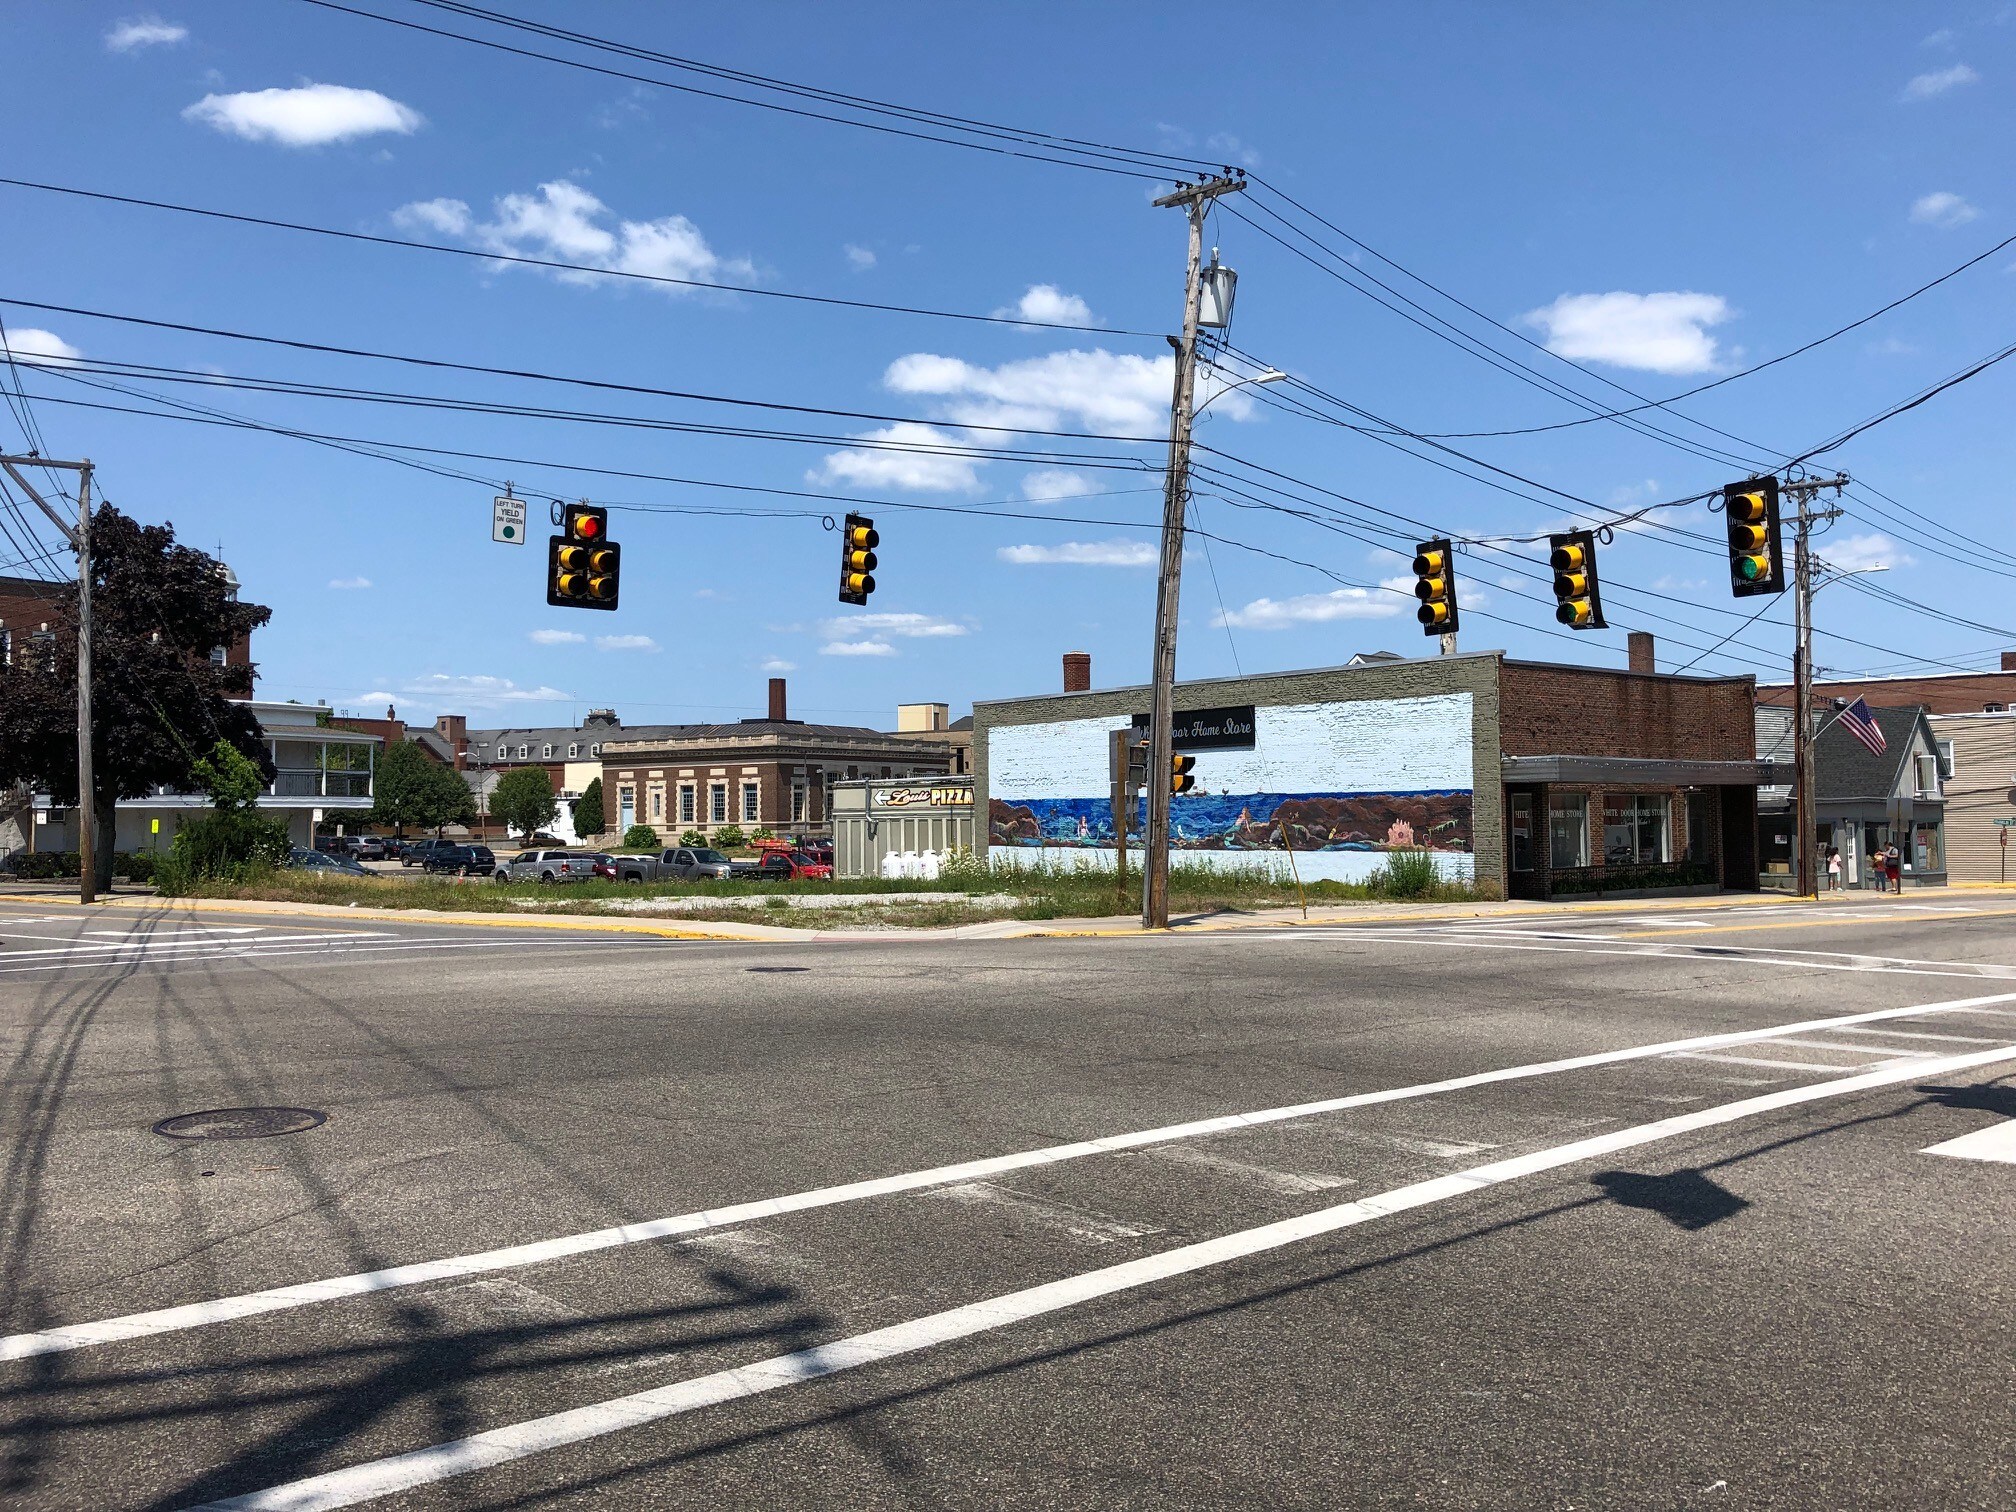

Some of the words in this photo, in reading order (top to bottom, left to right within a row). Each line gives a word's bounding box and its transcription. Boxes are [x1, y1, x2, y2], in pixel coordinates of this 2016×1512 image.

[501, 508, 519, 517] YIELD
[1171, 728, 1190, 738] oor
[1192, 720, 1220, 737] Home
[1223, 718, 1252, 734] Store
[931, 788, 975, 806] PIZZA
[1567, 809, 1583, 818] STORE
